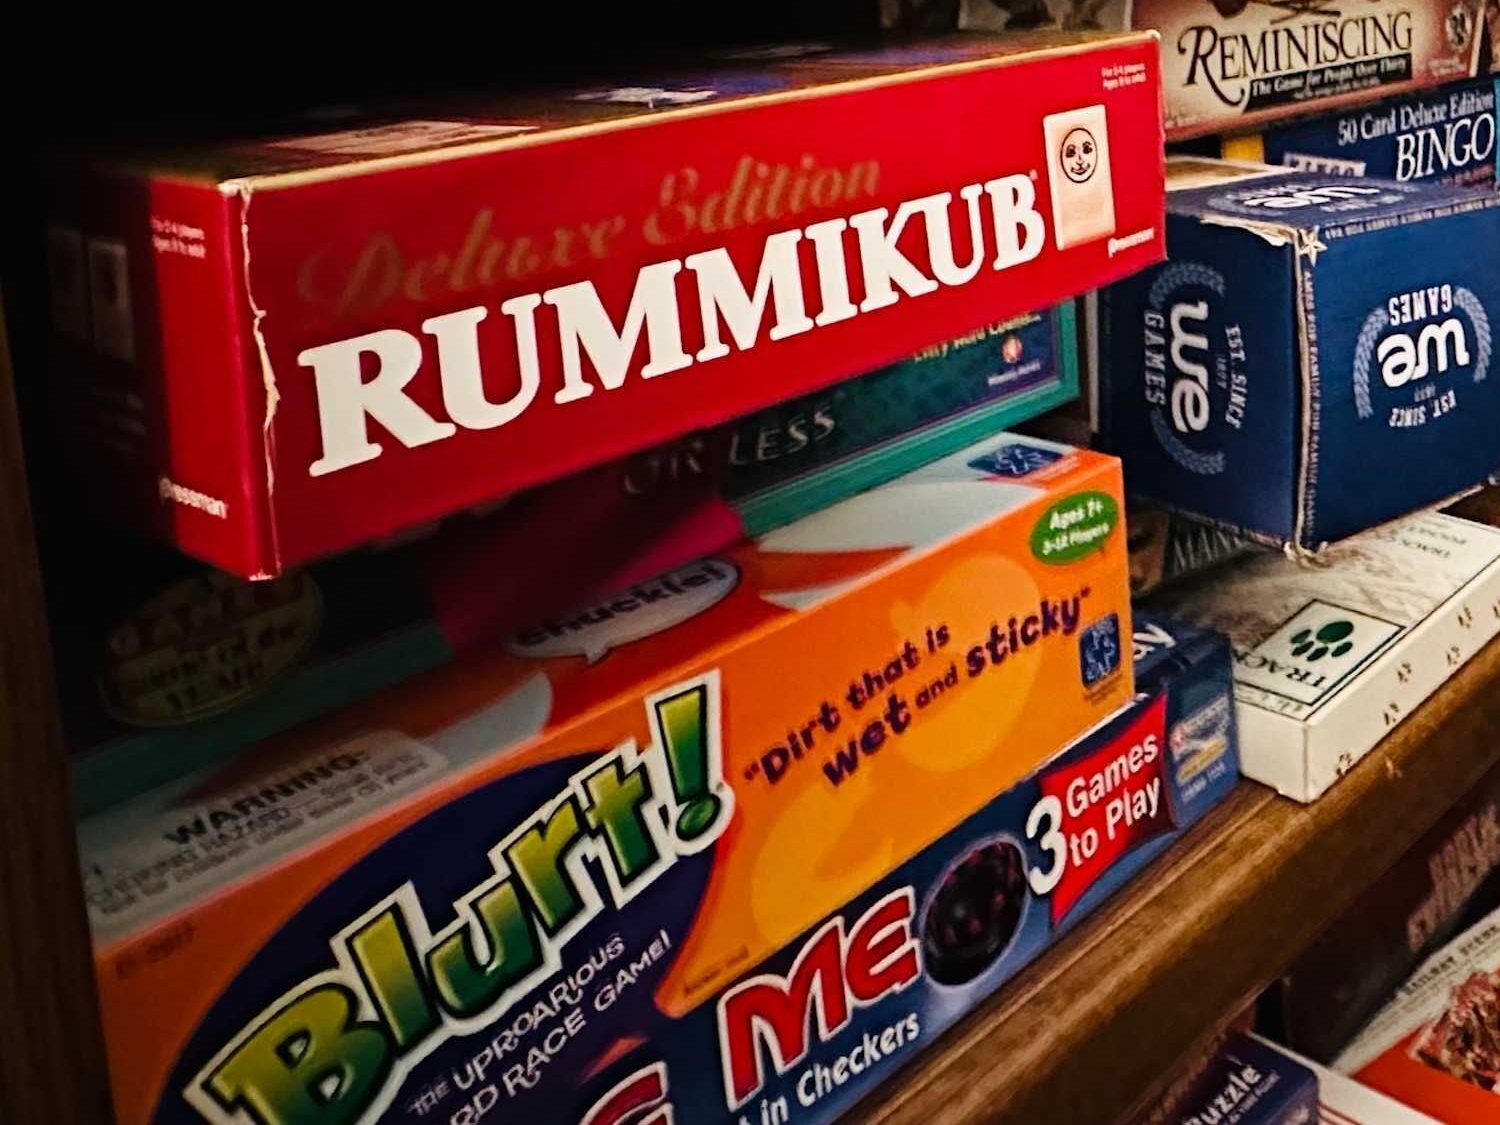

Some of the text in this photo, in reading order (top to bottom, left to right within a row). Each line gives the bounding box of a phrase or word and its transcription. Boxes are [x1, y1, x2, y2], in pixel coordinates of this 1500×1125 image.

[1177, 11, 1413, 107] REMINISCING
[1252, 79, 1272, 97] The
[1337, 90, 1495, 146] 50 Card Deluxe Edition
[1396, 113, 1495, 182] BINGO
[297, 208, 626, 315] Deluxe
[644, 153, 881, 247] Edition
[298, 173, 1046, 477] RUMMIKUB
[1389, 284, 1454, 326] GAMES
[1144, 311, 1167, 406] GAMES
[845, 642, 922, 709] that
[925, 622, 951, 656] is
[821, 695, 914, 790] wet
[915, 667, 959, 713] and
[1066, 731, 1160, 813] Games
[1025, 785, 1067, 897] 3
[1069, 775, 1162, 868] to Play
[183, 670, 736, 1125] Blurt!
[453, 932, 627, 1091] UPROARIOUS
[502, 1007, 587, 1098] RACE
[594, 928, 673, 1013] GAME!
[717, 884, 919, 1115] ME
[795, 1009, 921, 1107] Checkers
